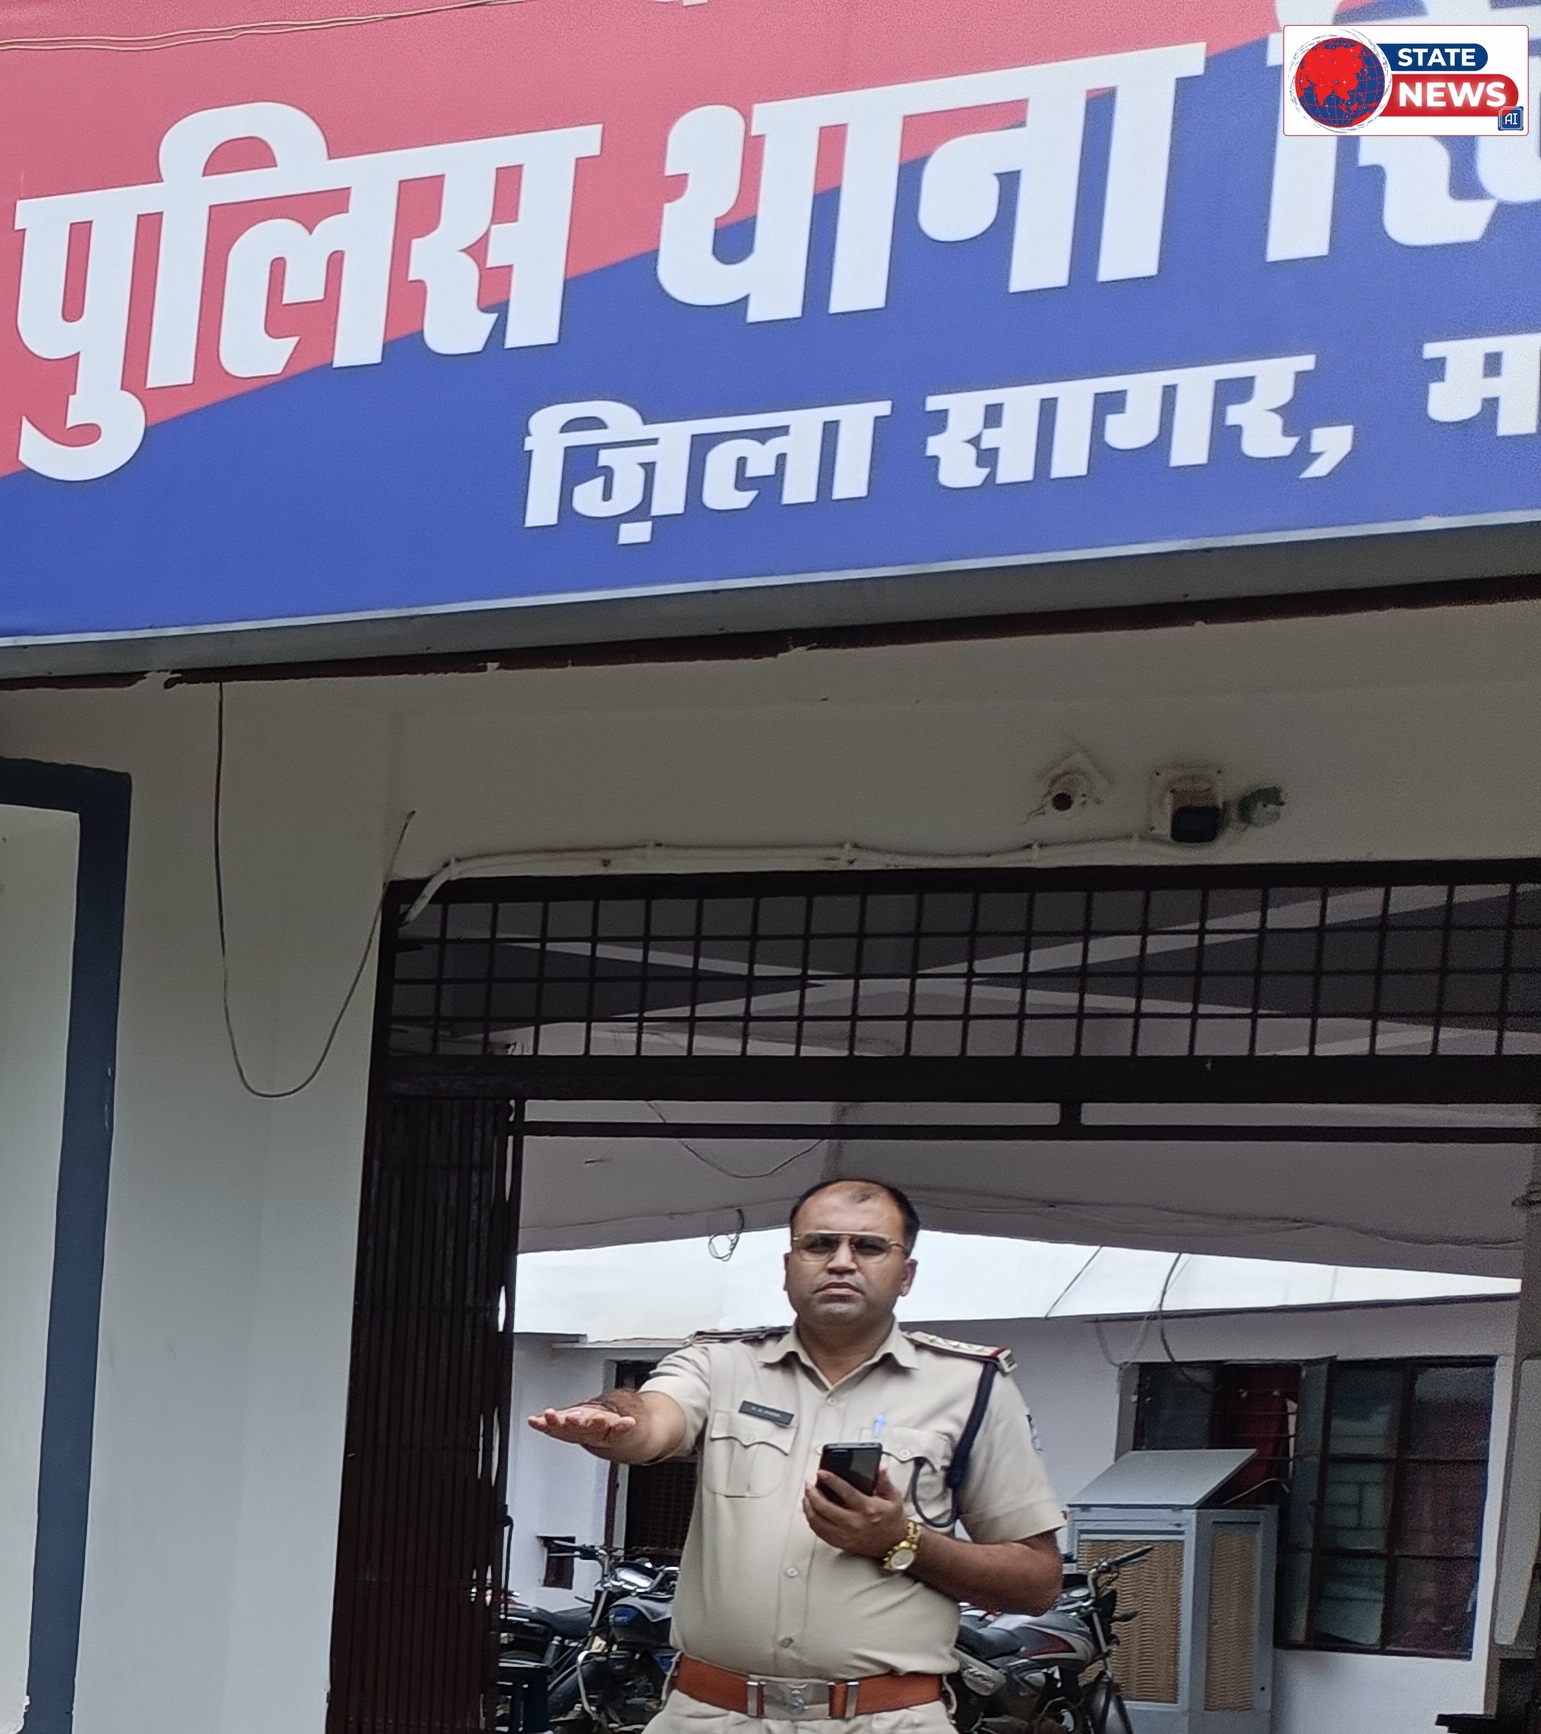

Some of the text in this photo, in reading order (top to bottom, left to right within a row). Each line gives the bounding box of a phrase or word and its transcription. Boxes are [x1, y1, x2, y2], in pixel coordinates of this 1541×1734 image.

[14, 101, 602, 483] पुलिस
[657, 42, 1206, 324] थाना
[925, 354, 1354, 489] सागर,
